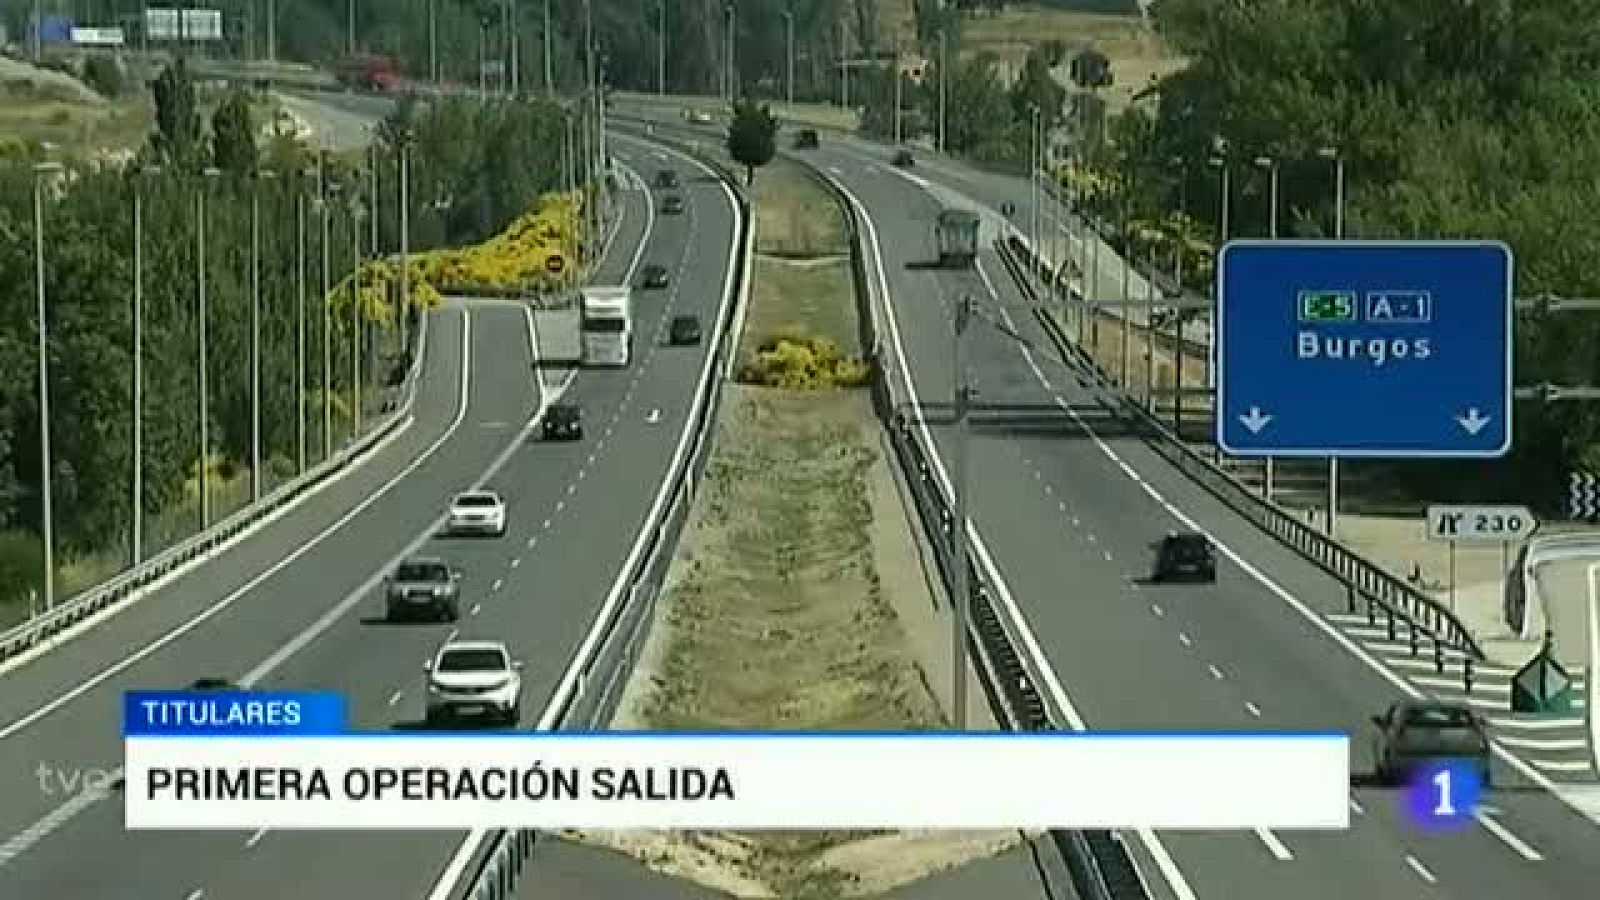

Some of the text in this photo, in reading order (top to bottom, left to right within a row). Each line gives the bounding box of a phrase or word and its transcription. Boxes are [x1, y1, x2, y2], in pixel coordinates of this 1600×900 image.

[1304, 296, 1424, 318] E-5 A-1
[1299, 331, 1431, 366] Burgos
[1474, 513, 1522, 533] 230
